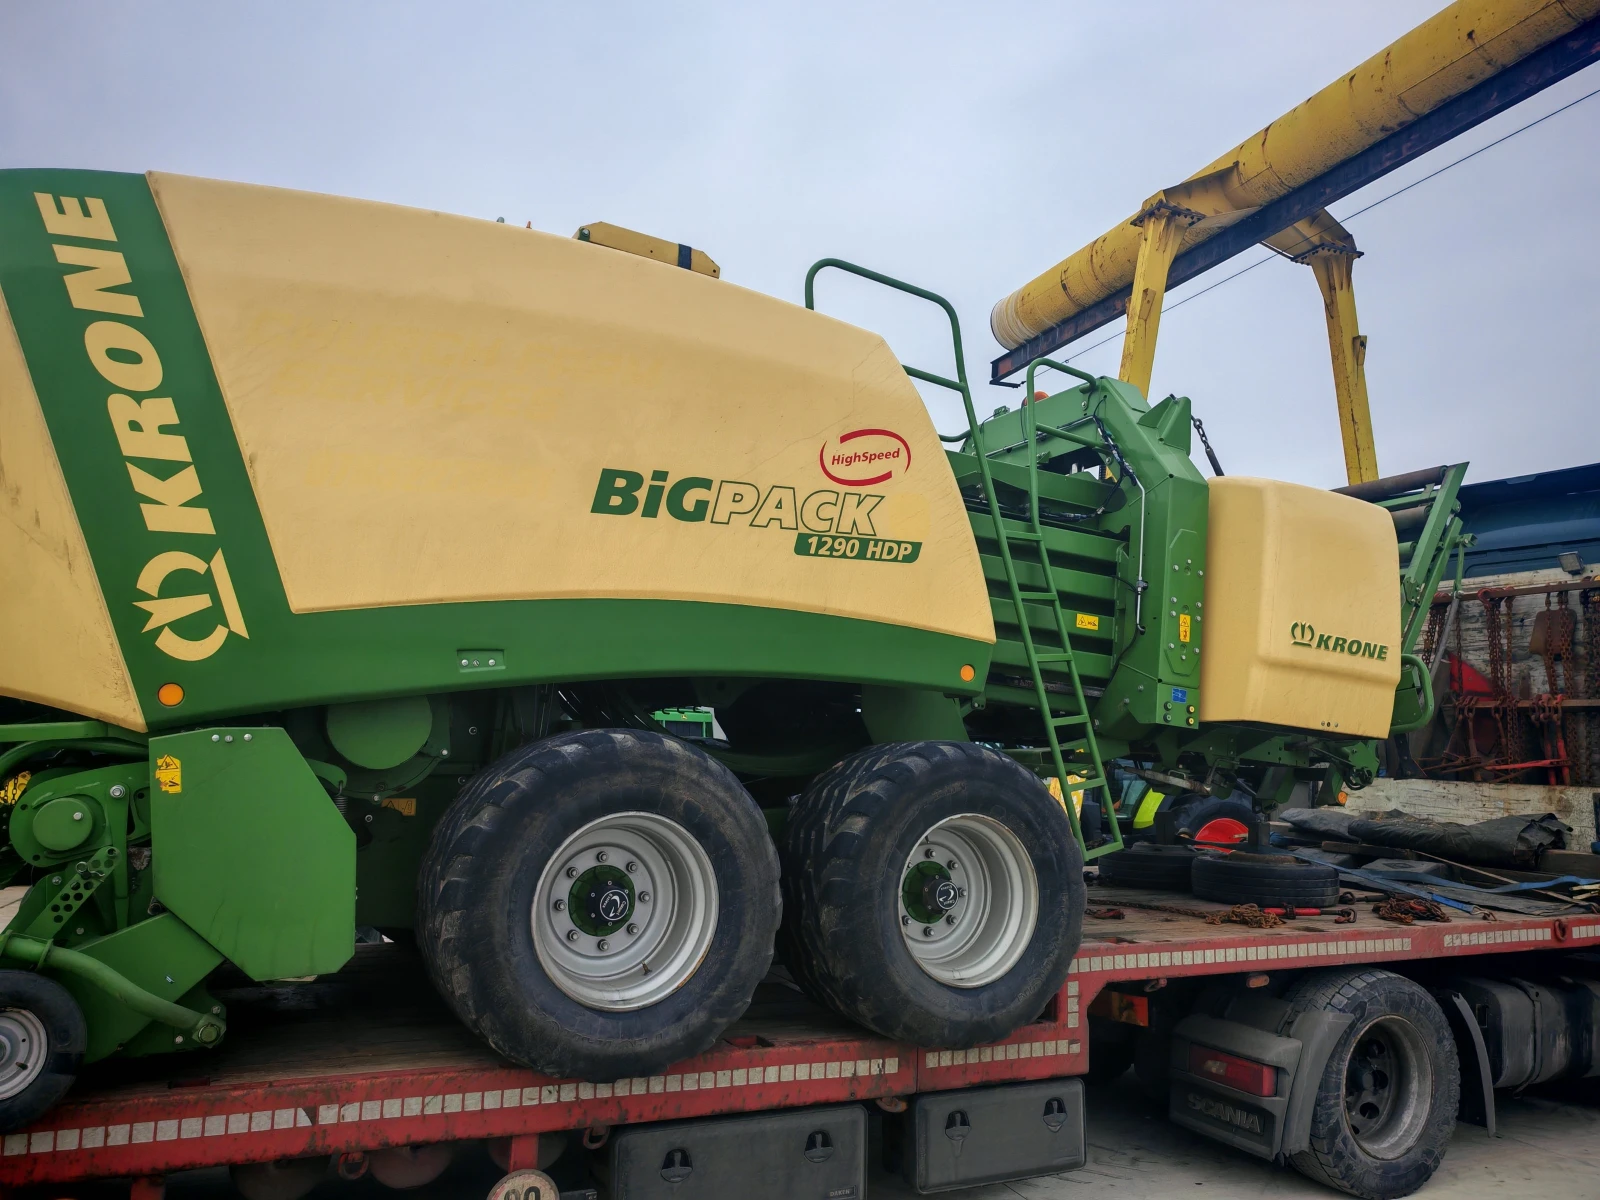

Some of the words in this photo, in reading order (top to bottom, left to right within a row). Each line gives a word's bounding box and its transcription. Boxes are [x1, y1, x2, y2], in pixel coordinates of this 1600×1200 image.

[33, 191, 217, 536] KRONE
[831, 447, 901, 467] HighSpeed
[807, 536, 860, 559] 1290
[866, 541, 913, 562] HDP
[1315, 633, 1389, 661] KRONE
[1187, 1093, 1261, 1133] SCANIA
